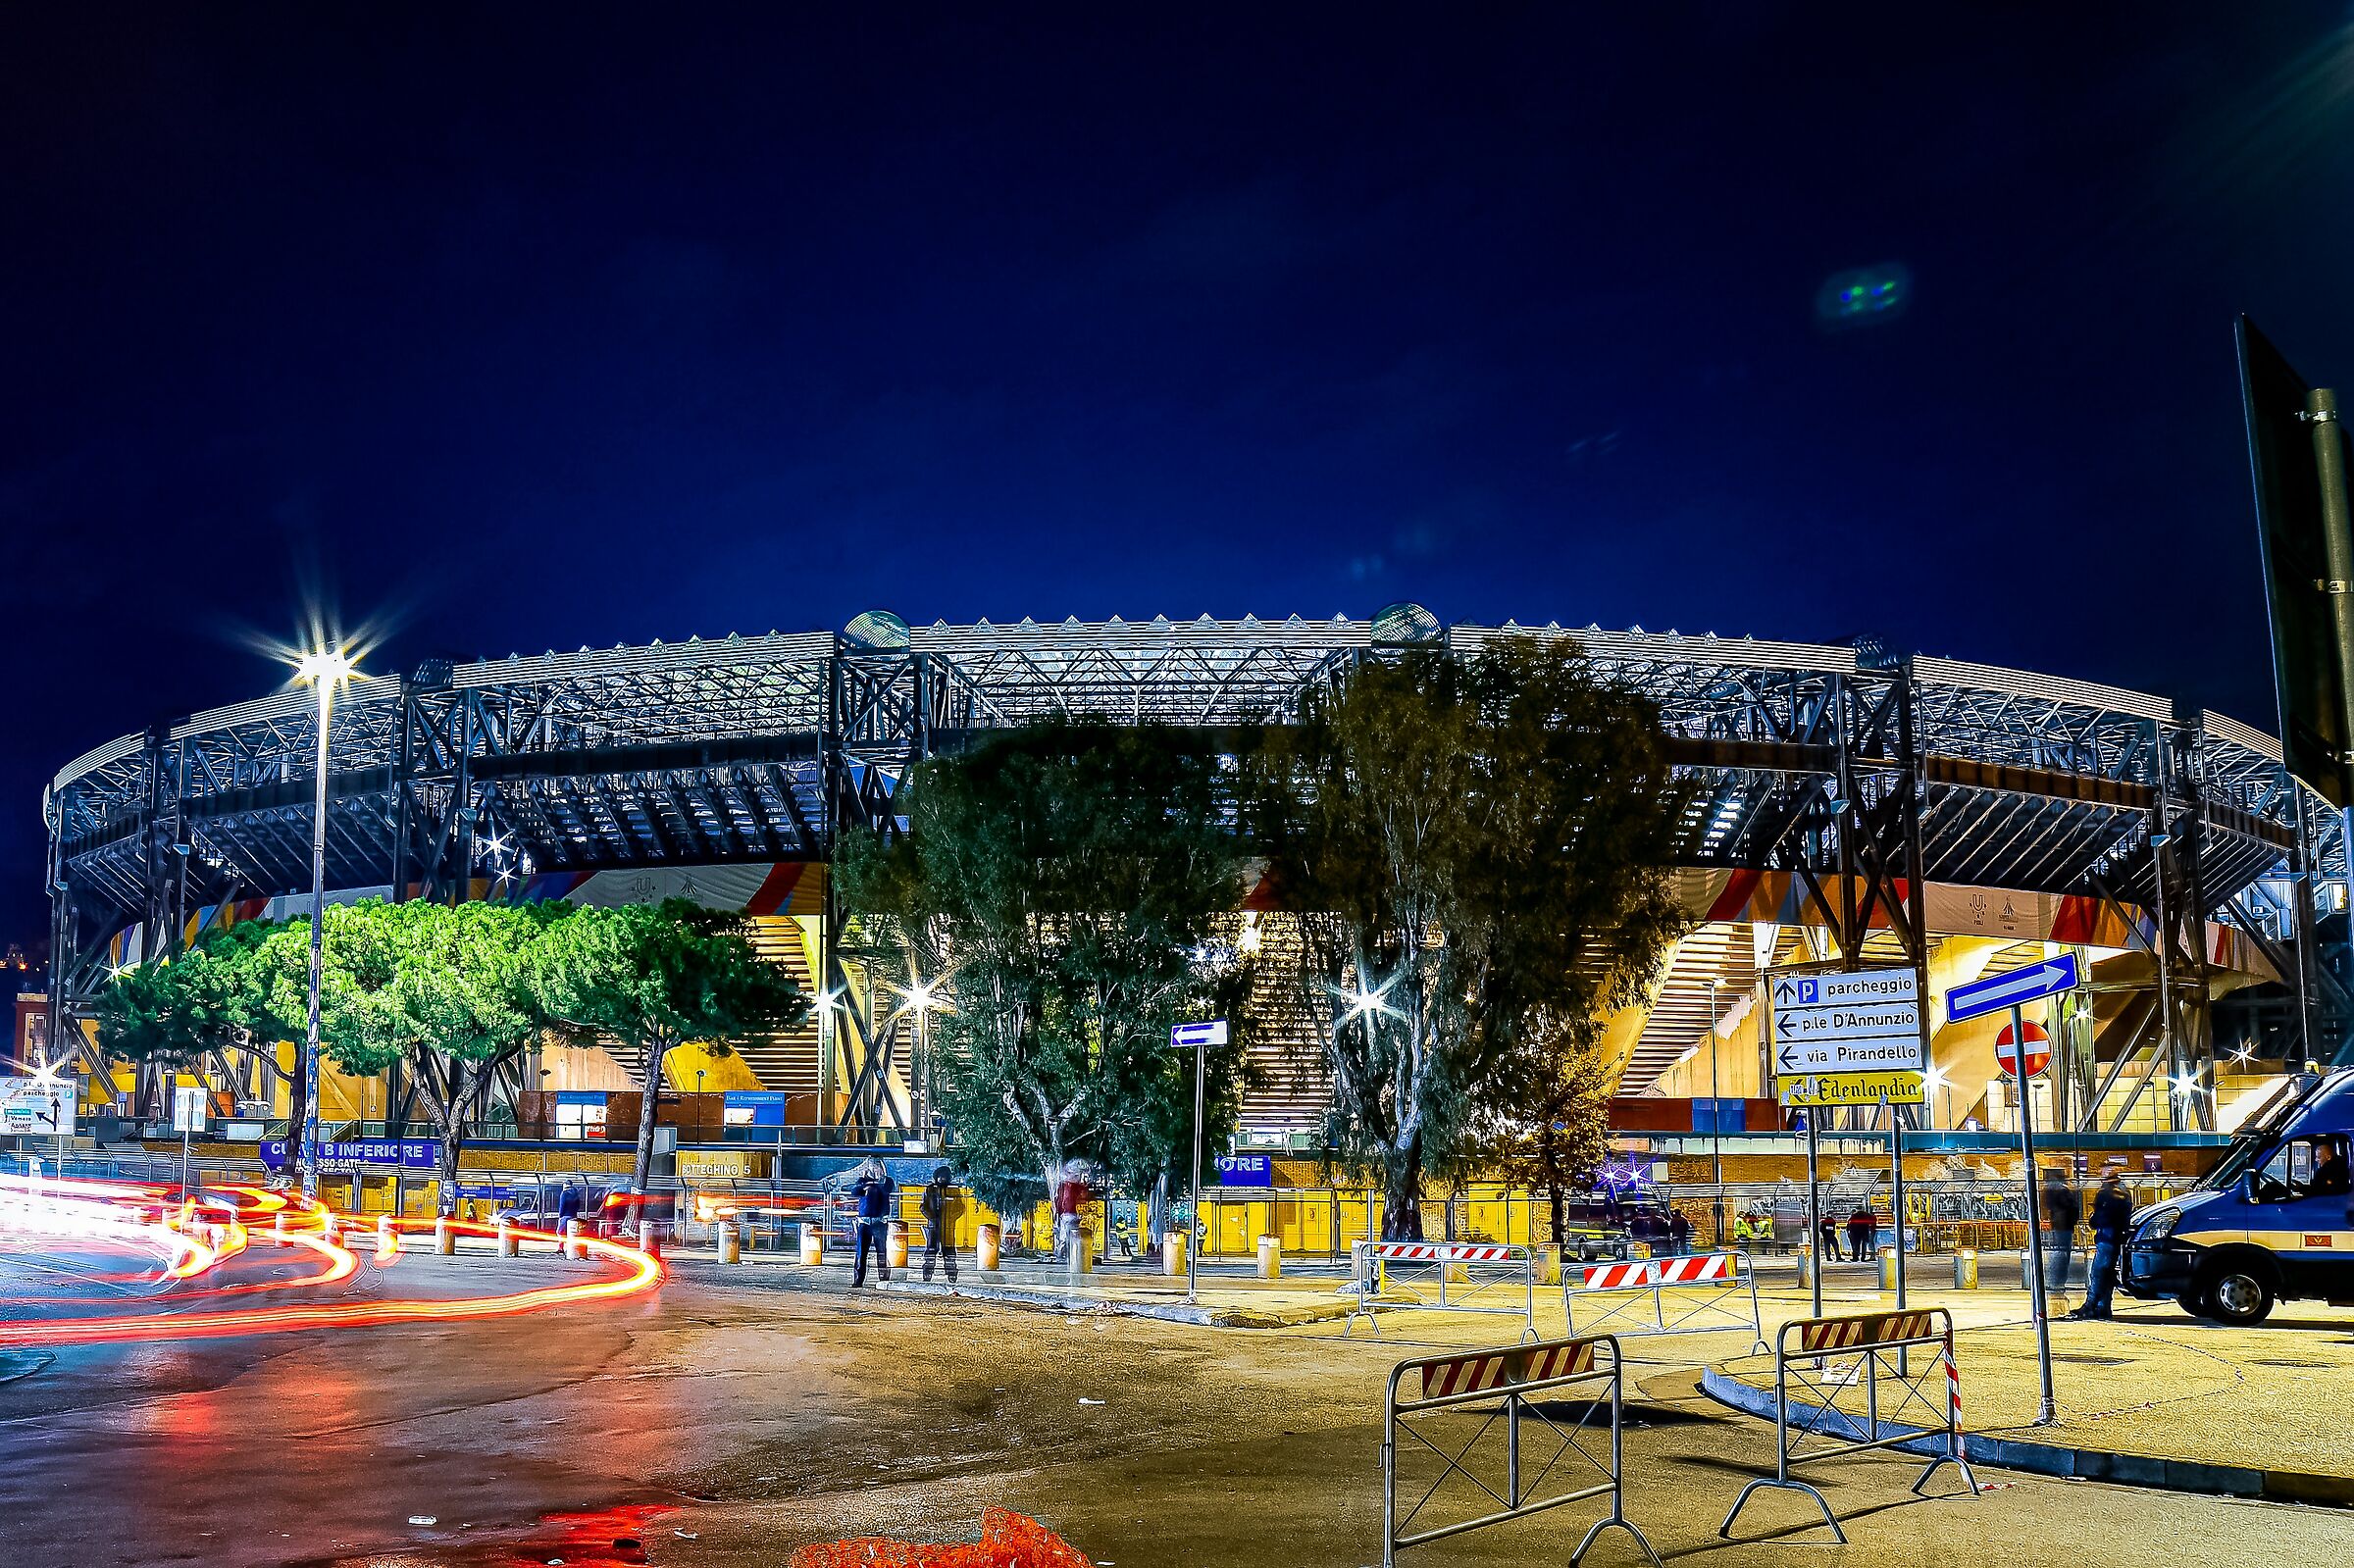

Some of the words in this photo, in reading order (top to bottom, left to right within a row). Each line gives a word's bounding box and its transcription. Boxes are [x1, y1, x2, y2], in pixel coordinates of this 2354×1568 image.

[1827, 976, 1913, 998] parcheggio
[1802, 1016, 1827, 1033] p.le
[1833, 1011, 1915, 1029] D'Annunzio
[1807, 1049, 1828, 1063] via
[1837, 1045, 1918, 1063] Pirandello
[1817, 1077, 1919, 1103] Edenlandia
[324, 1143, 334, 1157] B
